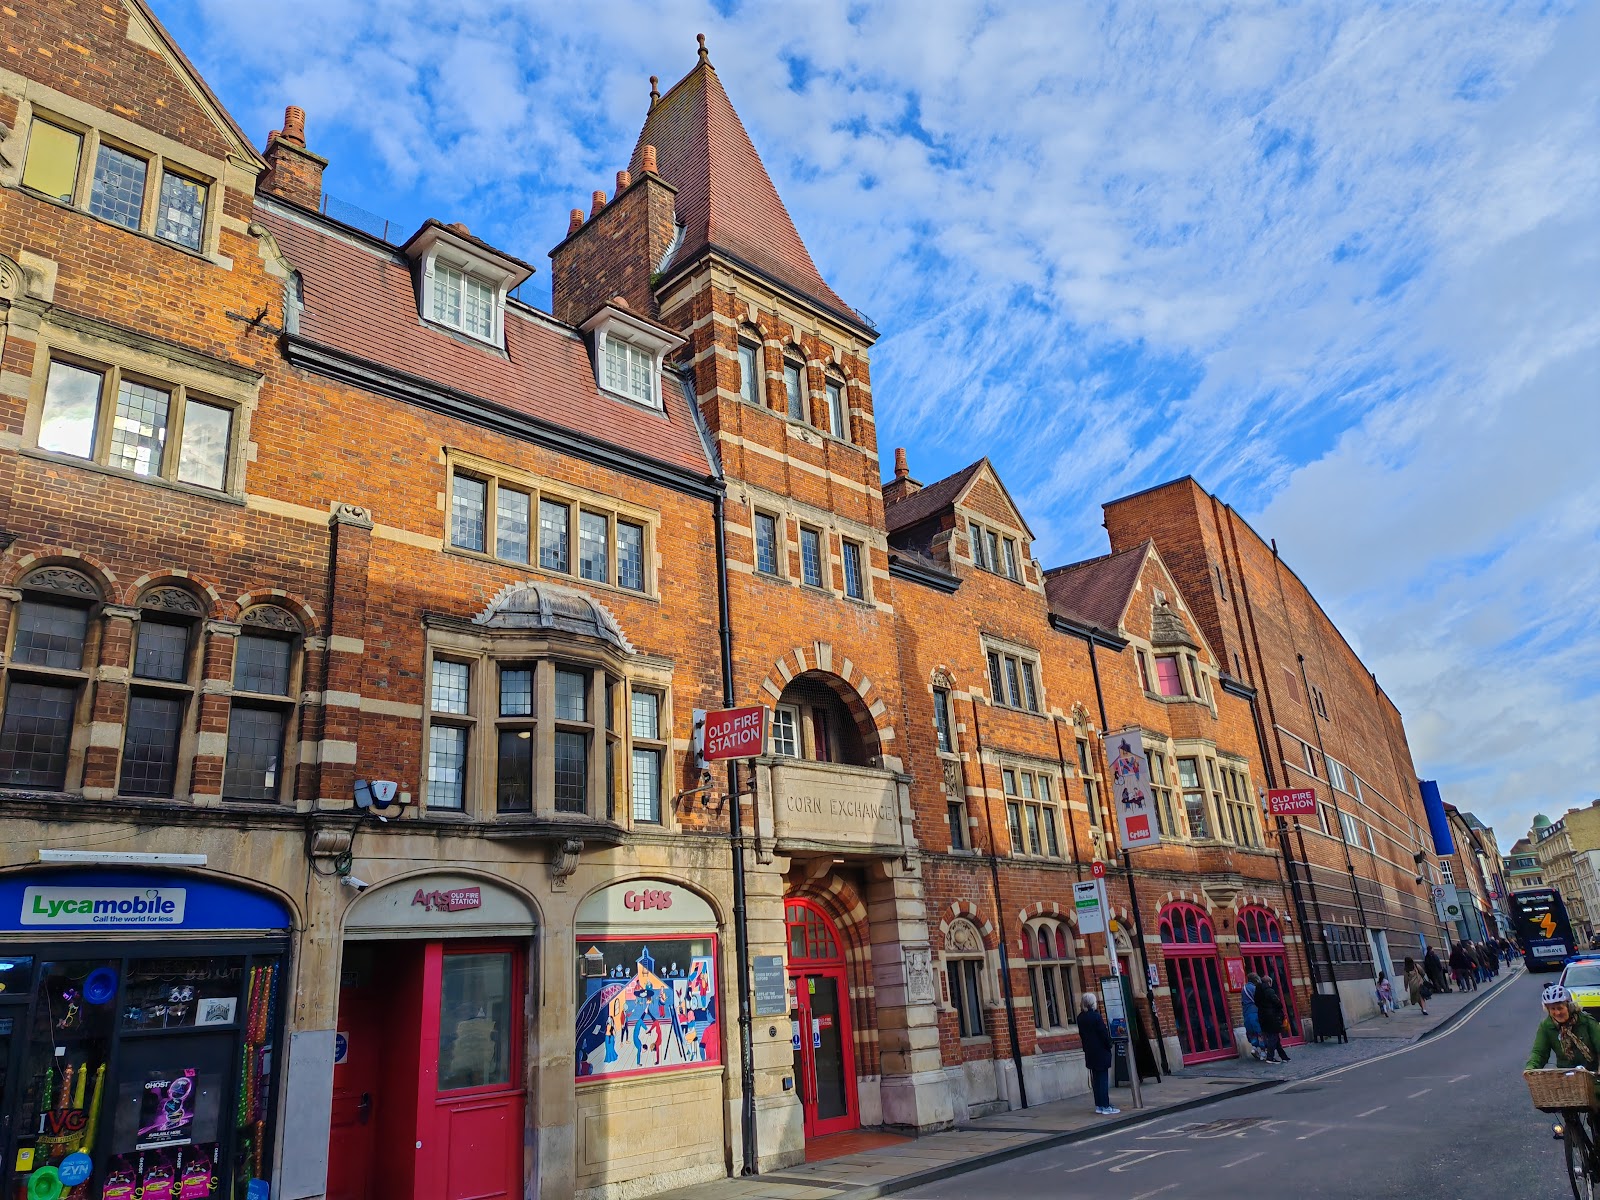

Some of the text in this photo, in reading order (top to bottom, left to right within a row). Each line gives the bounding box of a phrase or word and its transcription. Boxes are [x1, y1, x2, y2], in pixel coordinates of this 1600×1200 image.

[708, 711, 759, 739] OLD FIRE
[709, 725, 760, 754] STATION
[1271, 791, 1312, 804] OLD FIRE
[1273, 799, 1314, 812] STATION
[786, 796, 893, 821] CORN EXCHANGE
[1093, 865, 1103, 875] B1
[32, 890, 176, 918] Lycamobile
[411, 889, 449, 906] Arts
[624, 889, 672, 911] Crisis
[145, 1081, 169, 1090] GHOST
[62, 1164, 89, 1177] ZYN
